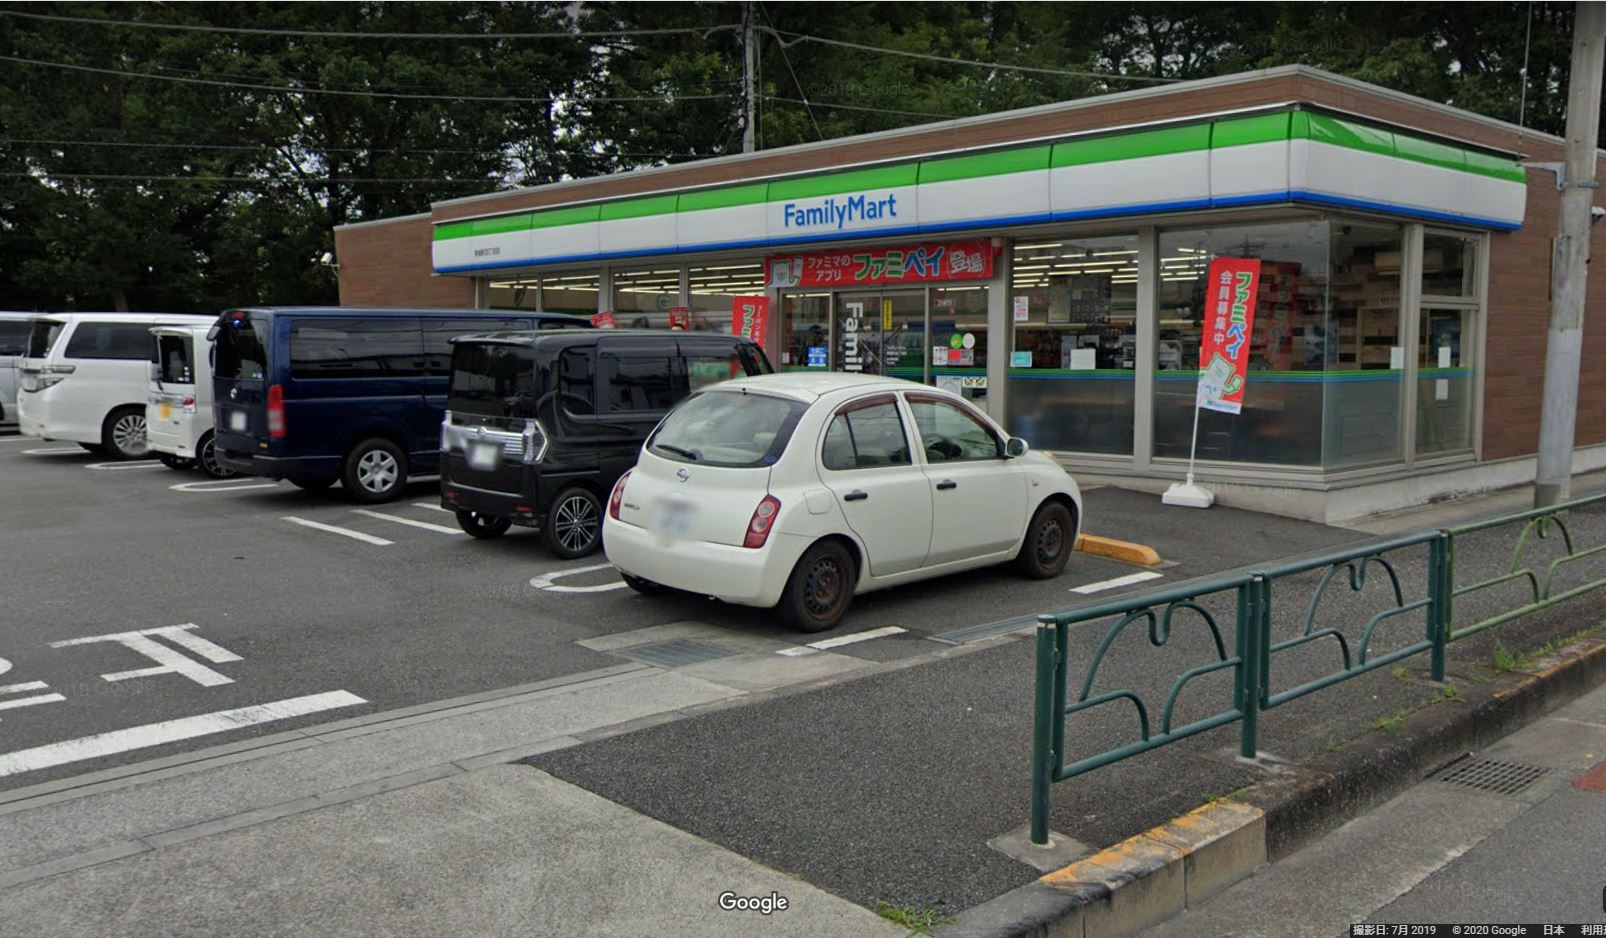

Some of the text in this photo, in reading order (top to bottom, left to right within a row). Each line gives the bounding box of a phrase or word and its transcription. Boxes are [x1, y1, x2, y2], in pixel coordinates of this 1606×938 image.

[784, 193, 897, 229] FamilyMart
[807, 255, 850, 269] ファミマの
[815, 270, 842, 281] アプリ
[852, 246, 945, 281] ファミペイ
[949, 250, 984, 274] 登場
[1213, 270, 1233, 346] 会員募集中
[1226, 271, 1253, 361] ファミペイ
[844, 302, 864, 374] Famil
